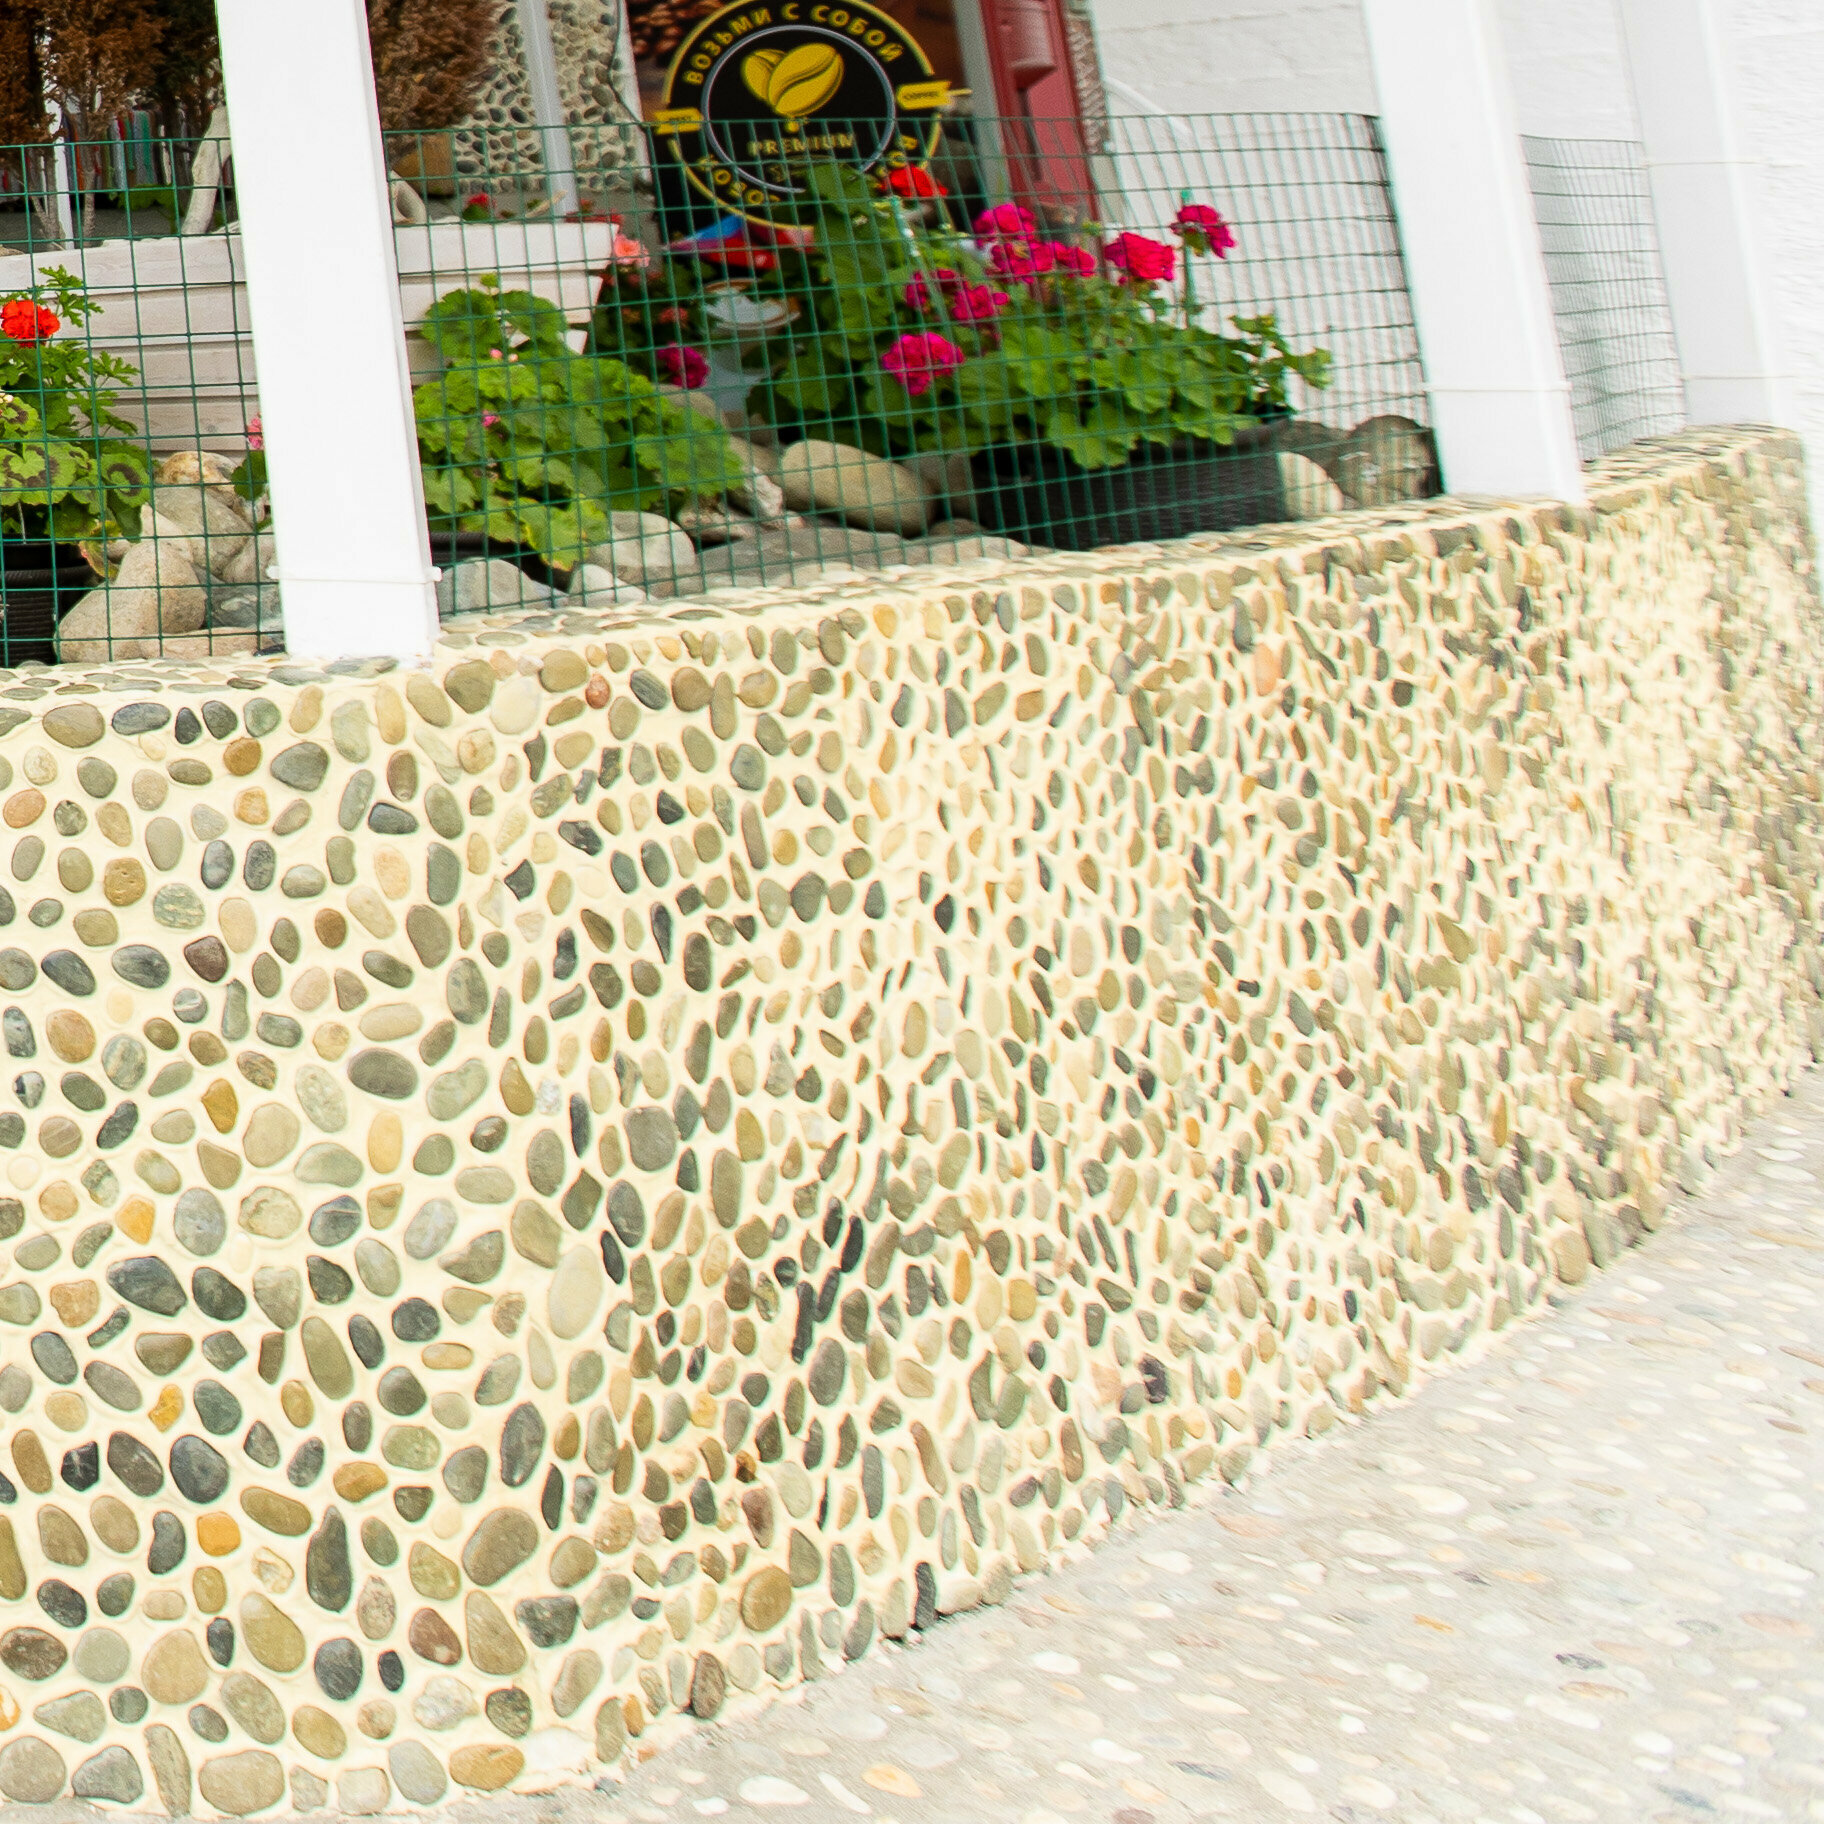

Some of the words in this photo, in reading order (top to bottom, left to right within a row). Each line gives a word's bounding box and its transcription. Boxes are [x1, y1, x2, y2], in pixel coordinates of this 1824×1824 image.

[682, 6, 773, 85] ВОЗЬМИ
[781, 2, 800, 20] С
[809, 4, 905, 63] СОБОЙ
